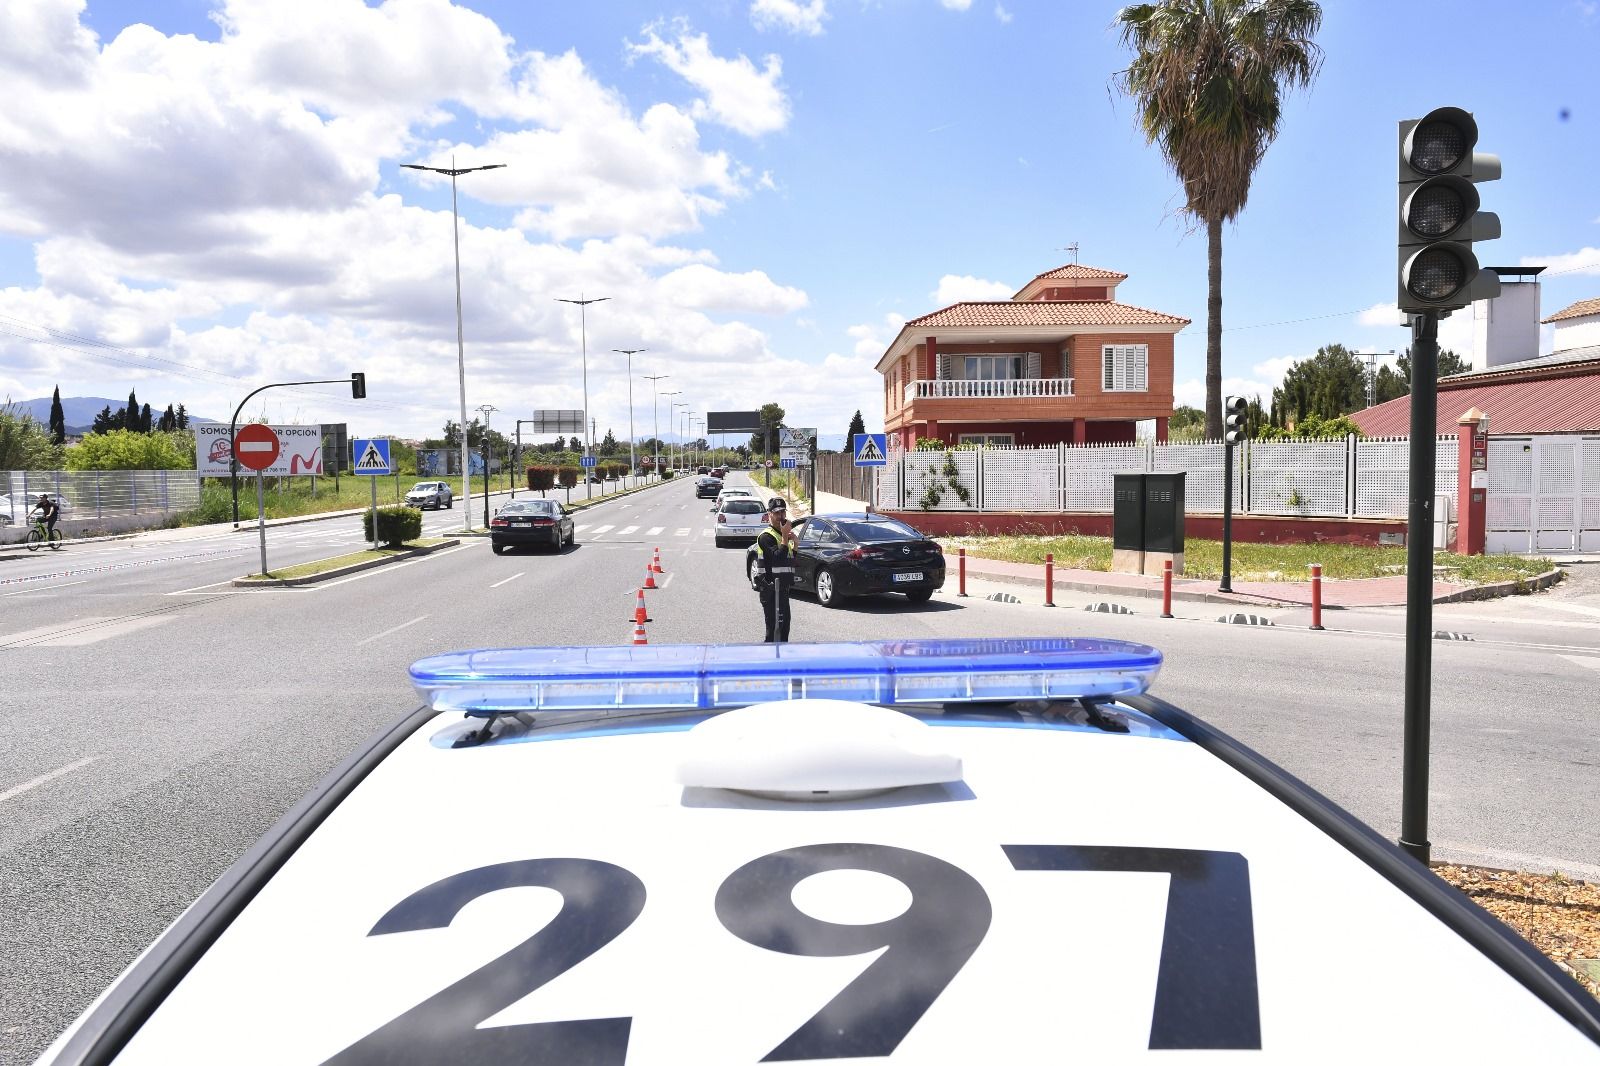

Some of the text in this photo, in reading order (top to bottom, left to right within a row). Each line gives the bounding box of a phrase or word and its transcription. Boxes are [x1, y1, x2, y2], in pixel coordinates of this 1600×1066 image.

[200, 427, 232, 435] SOMOS
[285, 427, 317, 436] OPCIÓN
[318, 842, 1263, 1066] 297
